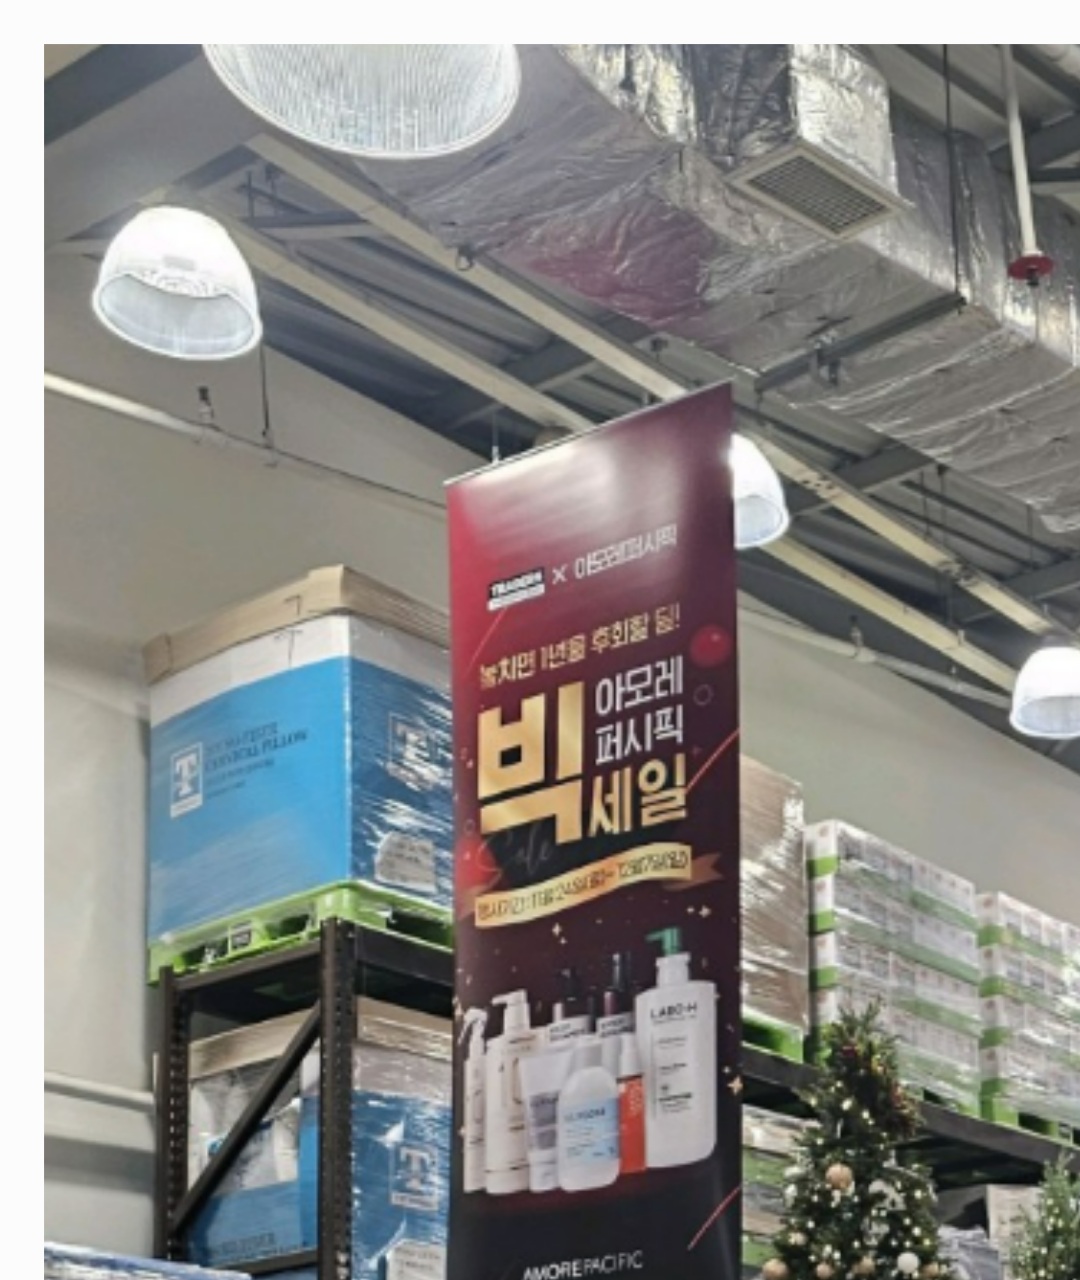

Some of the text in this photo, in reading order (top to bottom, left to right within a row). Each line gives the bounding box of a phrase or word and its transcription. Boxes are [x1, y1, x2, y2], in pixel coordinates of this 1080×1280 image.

[594, 654, 685, 718] 아모레
[476, 680, 586, 846] 빅
[595, 704, 685, 765] 퍼시픽
[588, 752, 688, 838] 세일
